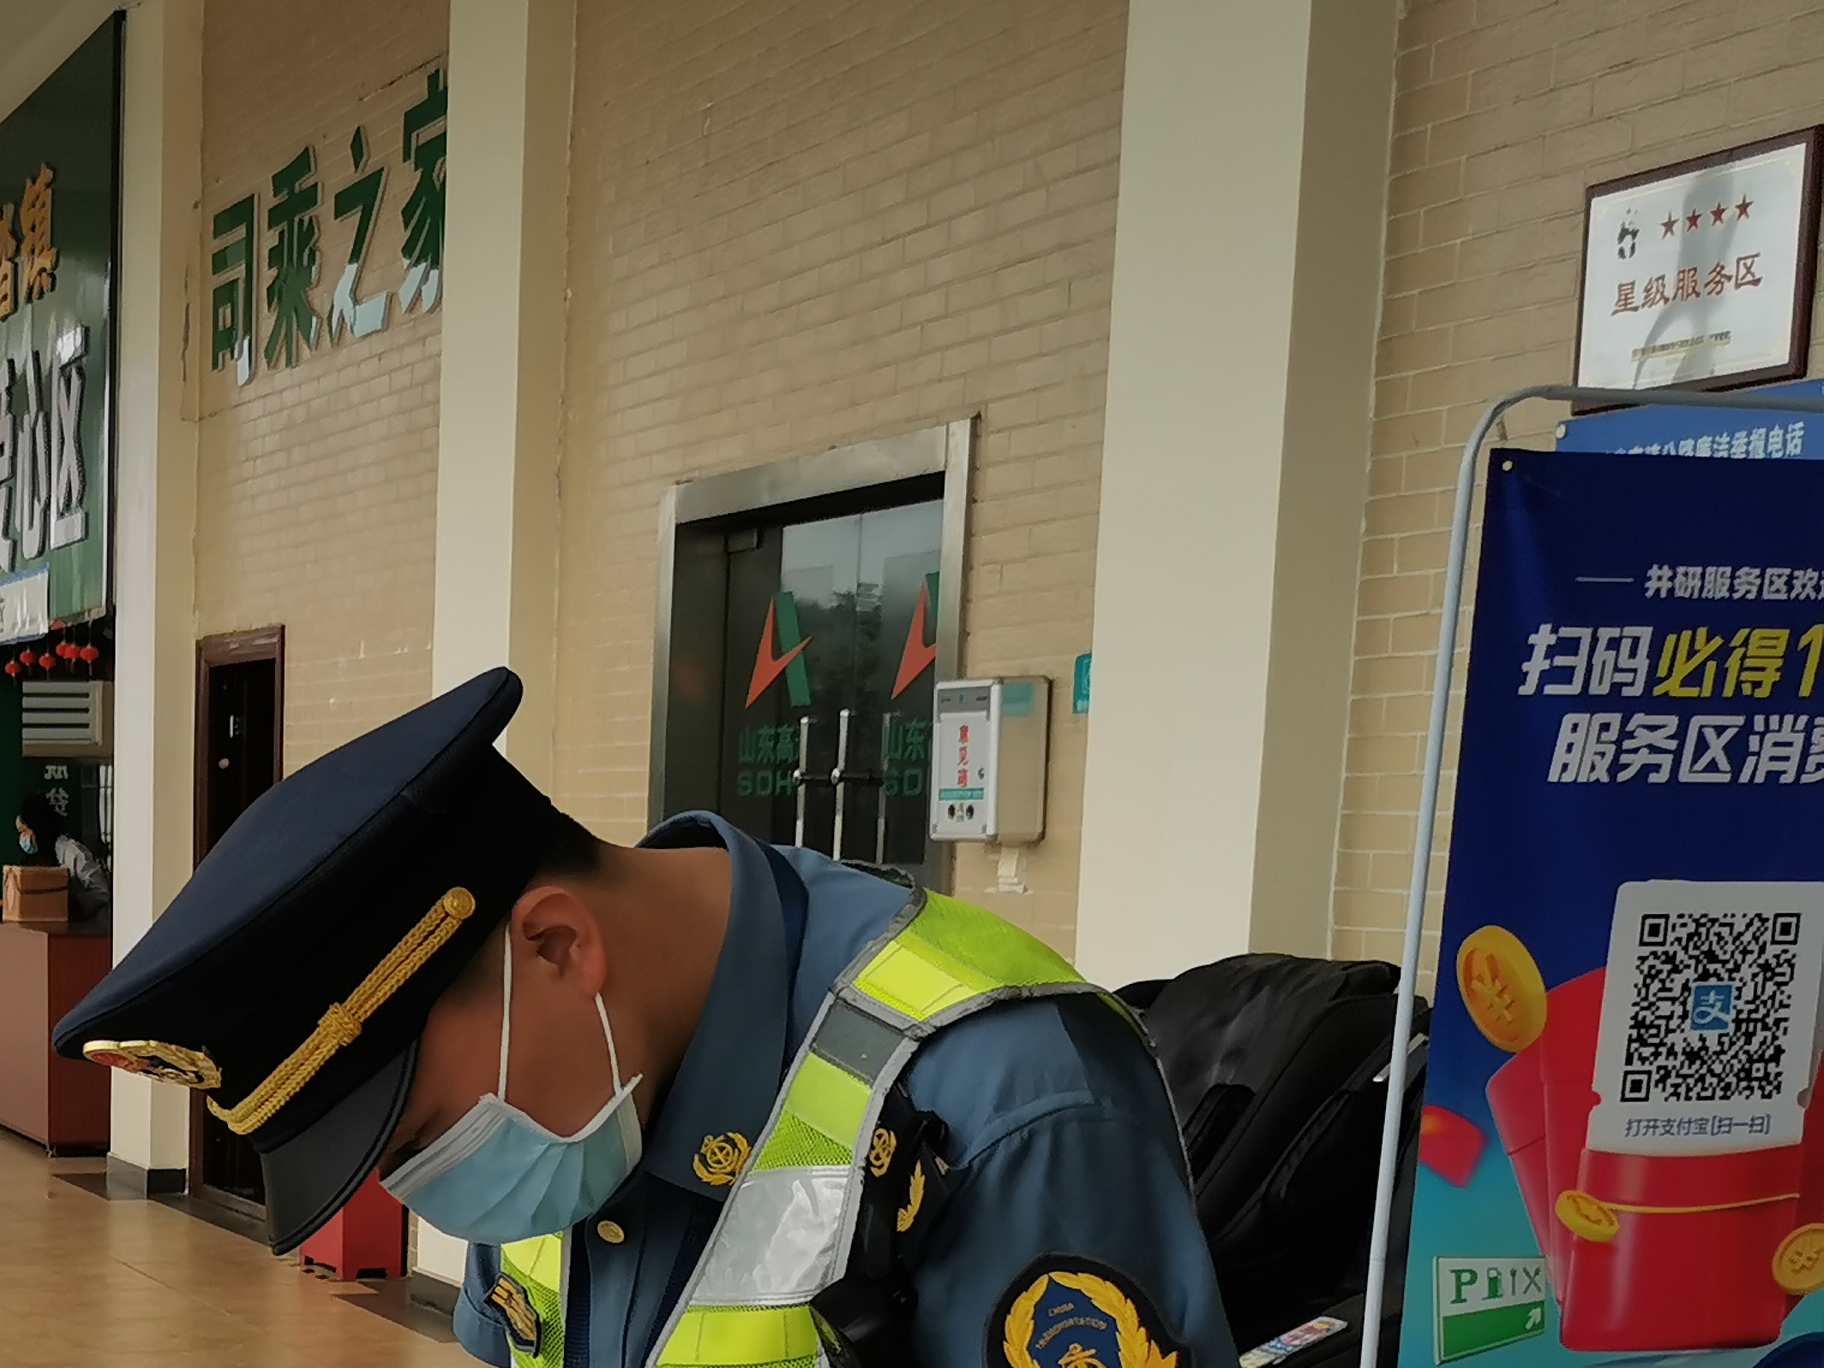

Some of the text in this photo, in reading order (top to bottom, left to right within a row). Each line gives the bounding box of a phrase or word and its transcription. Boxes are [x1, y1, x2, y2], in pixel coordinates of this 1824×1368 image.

[1610, 252, 1764, 317] 星级服务区
[1644, 563, 1824, 600] 井研服务区欢
